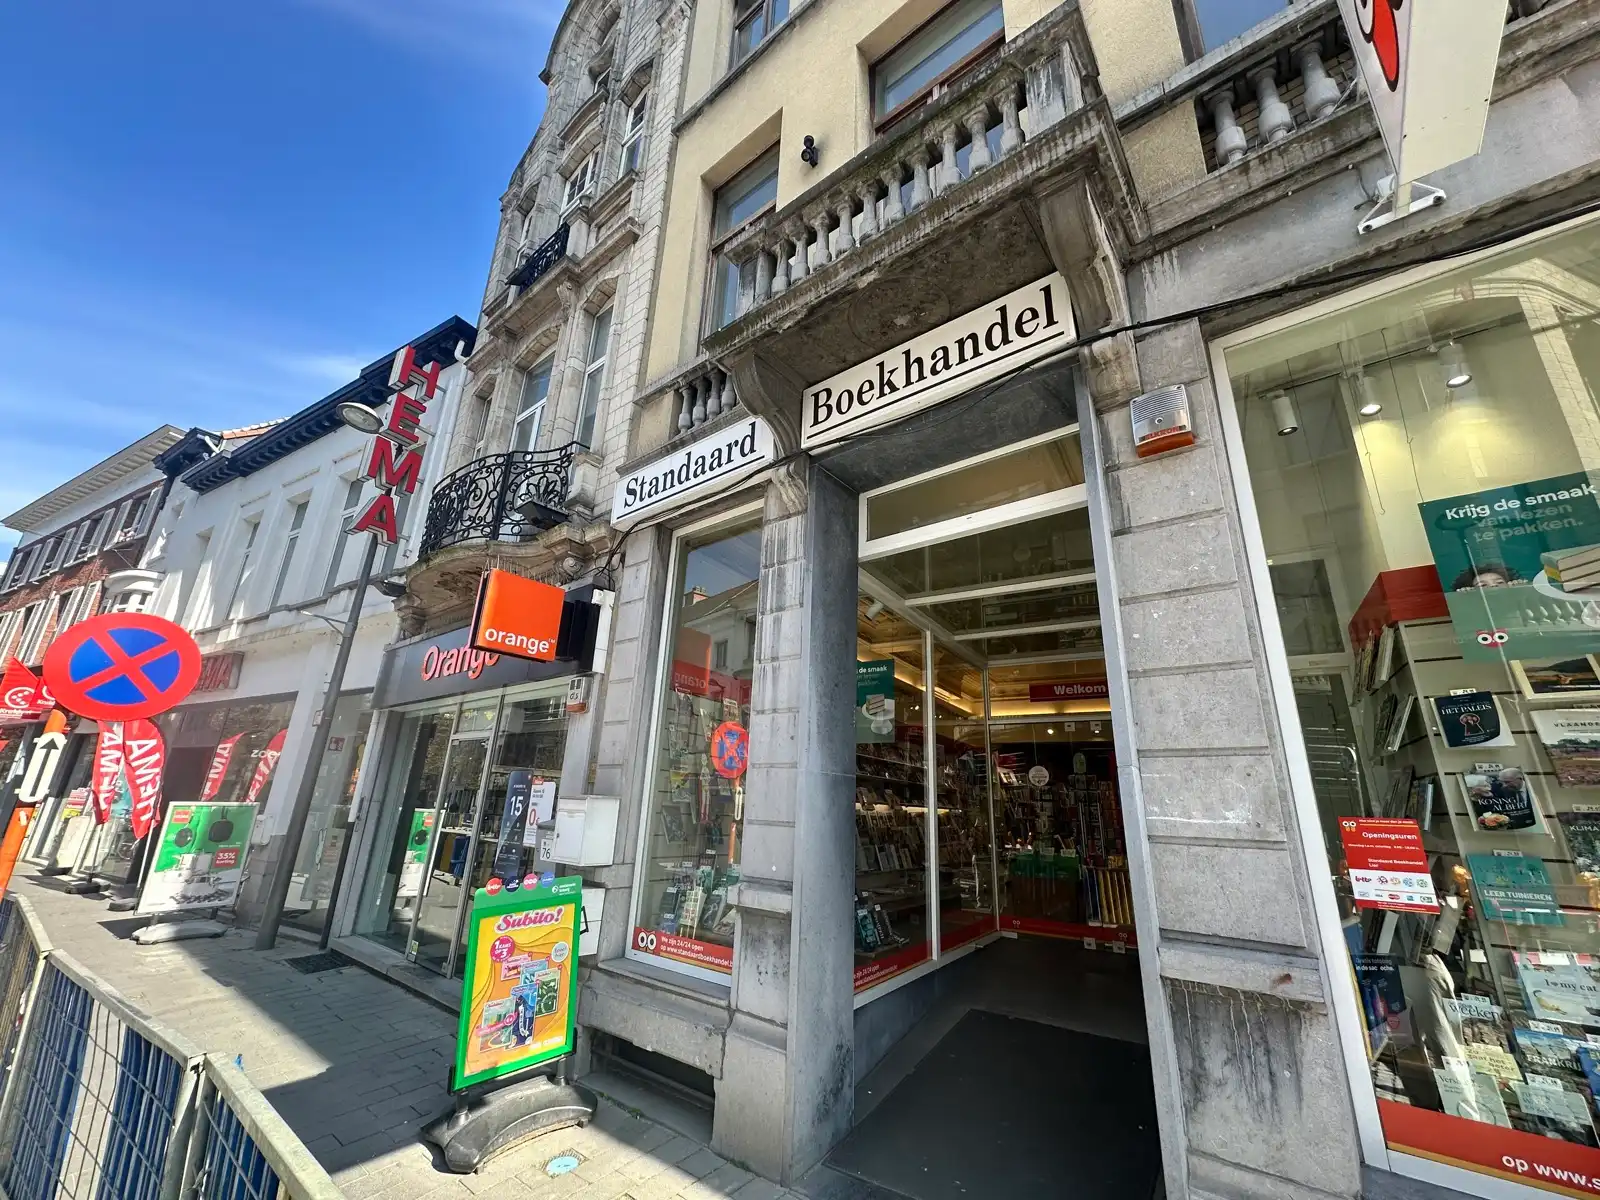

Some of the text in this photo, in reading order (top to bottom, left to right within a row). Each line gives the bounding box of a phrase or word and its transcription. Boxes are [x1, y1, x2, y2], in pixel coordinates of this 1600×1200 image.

[809, 284, 1059, 428] Boekhandel
[350, 345, 441, 545] HEMA
[623, 423, 757, 508] Standaard
[1446, 484, 1597, 520] Krijg de smaak
[1474, 504, 1572, 528] van lezen
[1474, 517, 1583, 542] te pakken.
[485, 629, 549, 654] orange
[1054, 684, 1107, 696] Welkom
[1461, 704, 1492, 714] PALEIS
[510, 795, 523, 816] 15
[1362, 832, 1417, 840] Openingsuren
[217, 852, 236, 860] 35%
[542, 848, 551, 859] 76
[1484, 890, 1552, 900] LEER TUINIEREN
[496, 907, 563, 932] Subito!
[668, 938, 676, 946] zijn
[676, 940, 691, 949] 24/24
[692, 943, 704, 952] open
[1560, 983, 1576, 991] my
[1502, 1156, 1528, 1173] op
